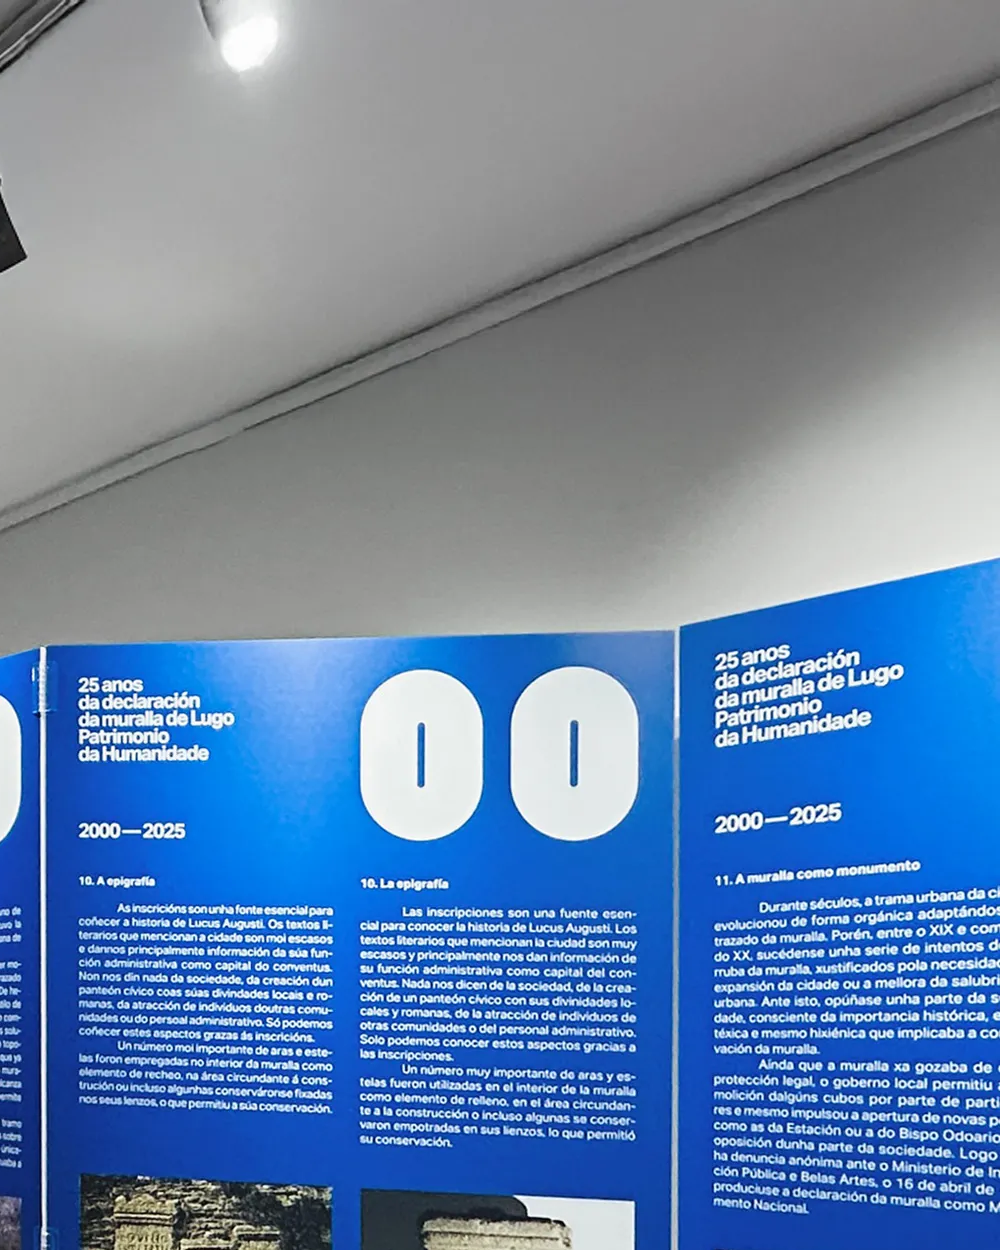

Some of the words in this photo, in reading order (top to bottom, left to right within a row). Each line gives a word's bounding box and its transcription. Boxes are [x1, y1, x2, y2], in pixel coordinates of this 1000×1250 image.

[715, 650, 739, 671] 25
[741, 643, 790, 667] anos
[715, 673, 739, 690] da
[741, 649, 860, 685] declaración
[78, 677, 100, 692] 25
[101, 679, 143, 692] anos
[715, 691, 739, 710] da
[741, 678, 814, 704] muralla
[817, 673, 845, 691] de
[848, 663, 904, 687] Lugo
[78, 694, 100, 710] da
[102, 692, 200, 709] declaración
[78, 712, 100, 726] da
[102, 711, 164, 727] muralla
[166, 711, 188, 726] de
[191, 710, 235, 729] Lugo
[715, 697, 822, 729] Patrimonio
[78, 728, 170, 744] Patrimonio
[715, 729, 739, 748] da
[742, 708, 871, 744] Humanidade
[78, 747, 100, 761] da
[102, 745, 209, 761] Humanidade
[360, 667, 638, 841] 00
[715, 875, 733, 886] 11.
[735, 873, 745, 885] A
[746, 870, 794, 884] muralla
[796, 866, 834, 880] como
[836, 859, 921, 877] monumento
[79, 876, 94, 886] 10.
[96, 876, 106, 886] A
[107, 876, 155, 889] epigrafía
[360, 878, 378, 889] 10.
[380, 879, 394, 889] La
[396, 878, 449, 891] epigrafía
[78, 916, 120, 926] coñecer
[122, 918, 129, 926] a
[131, 917, 170, 927] historia
[172, 917, 186, 928] de
[188, 917, 220, 928] Lucus
[222, 918, 265, 931] Augusti.
[267, 918, 284, 929] Os
[285, 919, 320, 930] textos
[322, 919, 333, 929] li-
[78, 957, 101, 967] ción
[103, 957, 177, 969] administrativa
[180, 961, 211, 970] como
[214, 960, 251, 973] capital
[254, 961, 269, 971] do
[272, 961, 332, 973] conventus.
[360, 965, 374, 973] su
[377, 962, 419, 974] función
[422, 964, 502, 976] administrativa
[506, 967, 540, 976] como
[543, 966, 583, 979] capital
[586, 967, 605, 978] del
[608, 969, 636, 978] con-
[713, 1012, 746, 1024] dade,
[748, 1011, 817, 1023] consciente
[819, 1010, 836, 1022] da
[839, 1010, 919, 1024] importancia
[922, 1008, 988, 1023] histórica,
[78, 1025, 121, 1036] coñecer
[122, 1027, 151, 1037] estes
[153, 1029, 201, 1041] aspectos
[203, 1031, 238, 1042] grazas
[240, 1030, 253, 1041] ás
[255, 1030, 315, 1043] inscricións.
[360, 1048, 376, 1059] las
[377, 1049, 454, 1063] inscripciones.
[713, 1043, 752, 1054] vación
[754, 1043, 770, 1054] da
[772, 1043, 820, 1054] muralla.
[713, 1196, 751, 1209] mento
[753, 1198, 808, 1214] Nacional.
